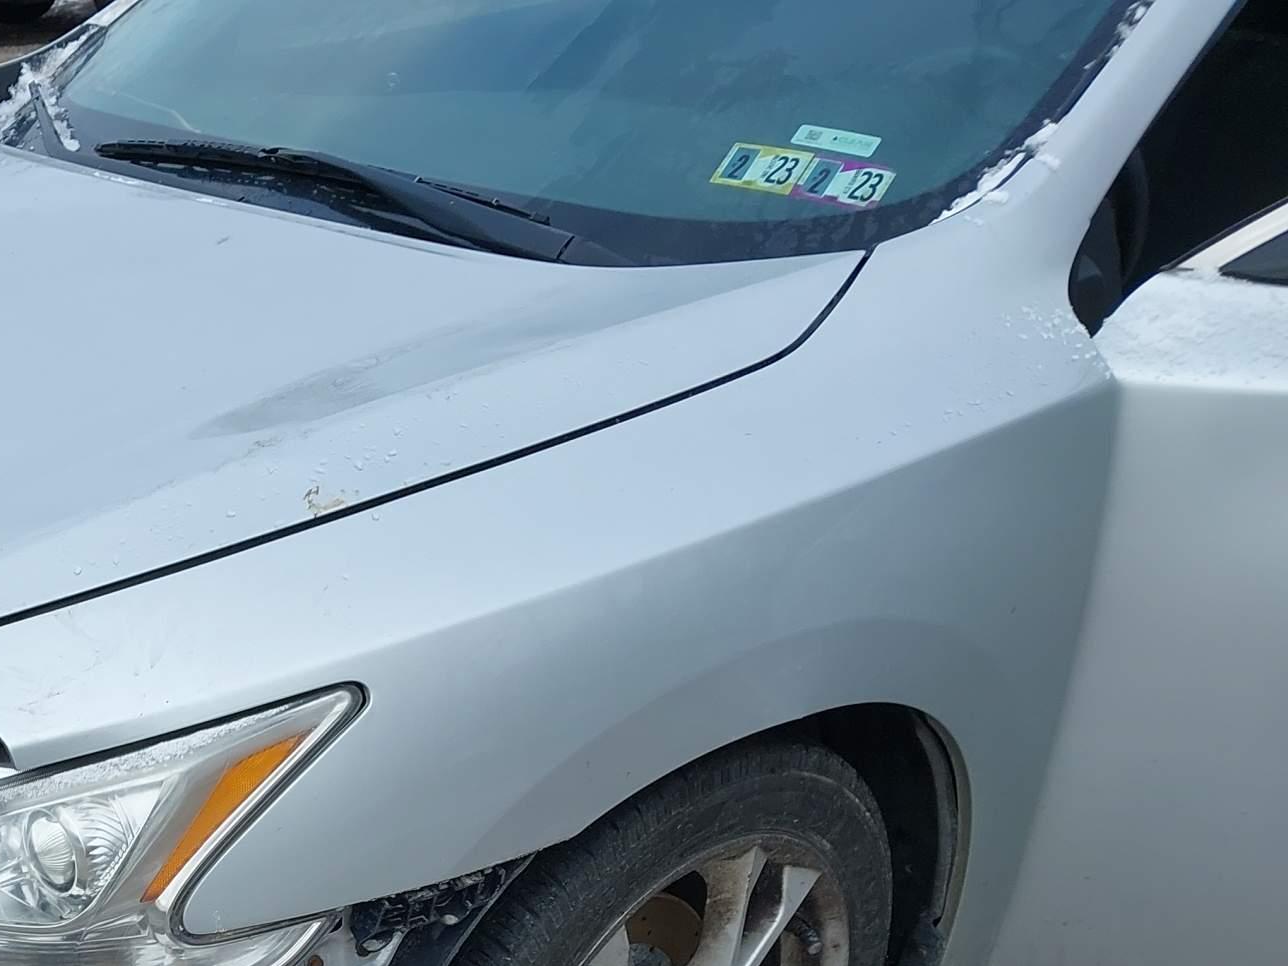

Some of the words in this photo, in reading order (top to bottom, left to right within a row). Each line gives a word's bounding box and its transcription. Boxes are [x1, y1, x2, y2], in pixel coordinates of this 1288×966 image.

[727, 154, 750, 180] 2
[764, 155, 800, 185] 23
[806, 167, 832, 194] 2
[847, 170, 884, 202] 23
